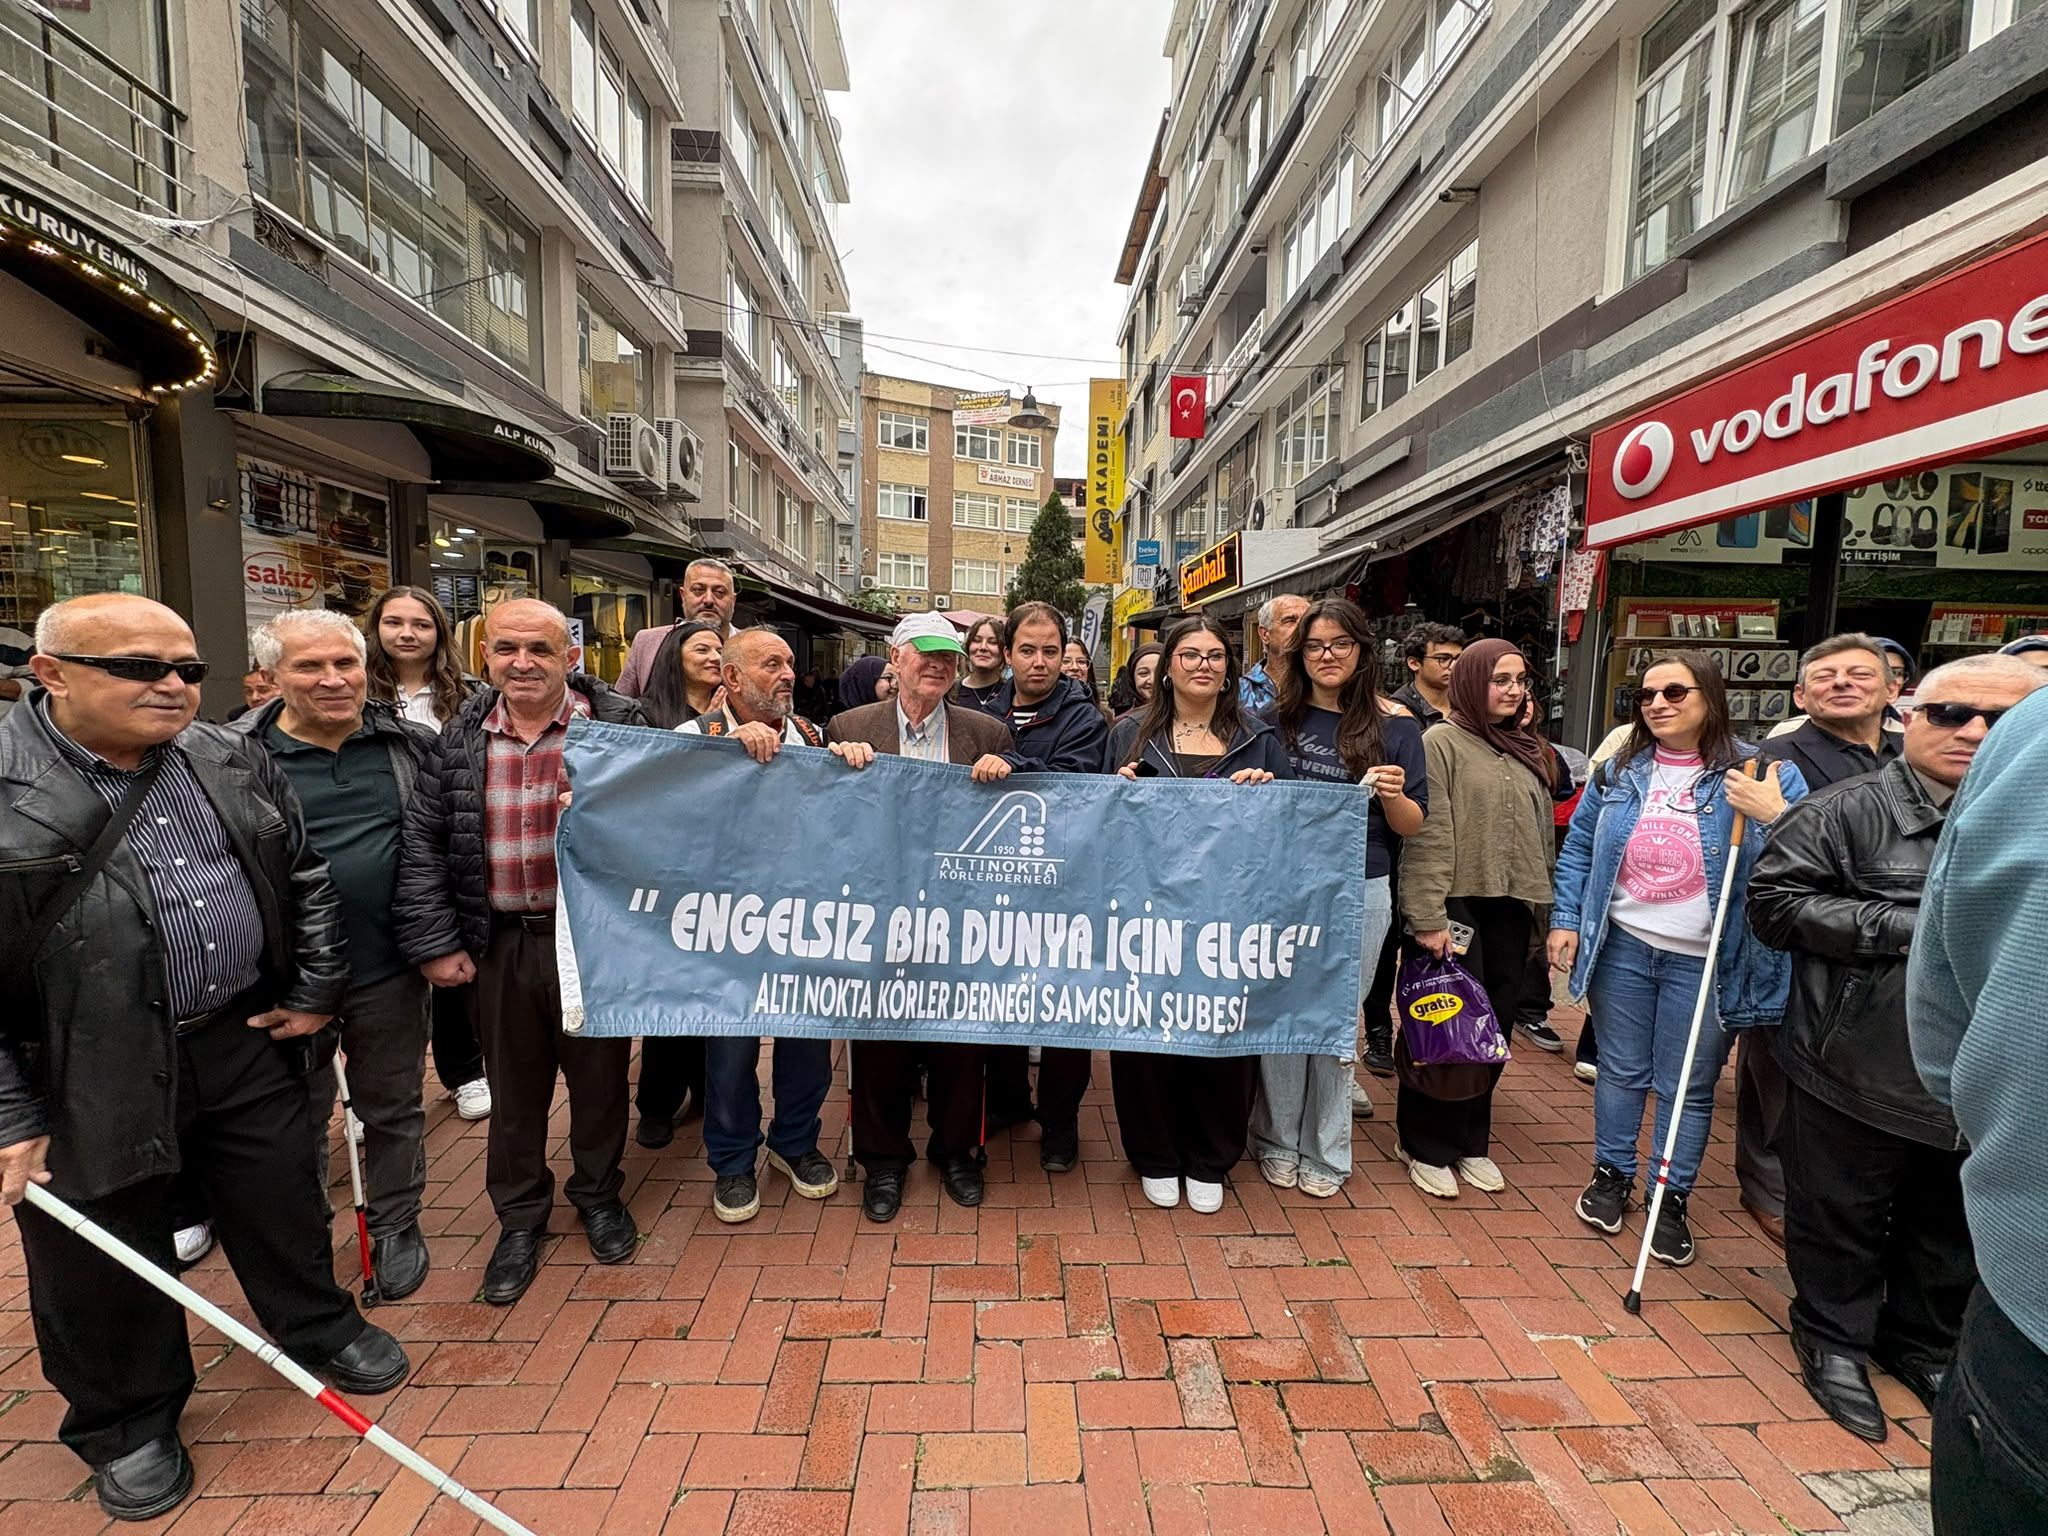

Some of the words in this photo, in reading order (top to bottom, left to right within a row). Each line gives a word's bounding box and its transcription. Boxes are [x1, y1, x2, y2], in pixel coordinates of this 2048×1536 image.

[1690, 293, 2048, 464] vodafone
[494, 424, 521, 440] ALP
[1854, 550, 1901, 563] İLETİŞİM
[993, 845, 1015, 855] 1950
[885, 889, 950, 964] BİR
[961, 893, 1093, 970] DÜNYA
[1105, 898, 1183, 991] İÇİN
[754, 972, 800, 1015] ALTI
[803, 974, 872, 1019] NOKTA
[876, 968, 950, 1020] KÖRLER
[952, 972, 1037, 1024] DERNEĞİ
[1039, 982, 1152, 1028] SAMSUN
[1159, 984, 1249, 1042] ŞUBESİ
[1414, 995, 1457, 1017] gratis
